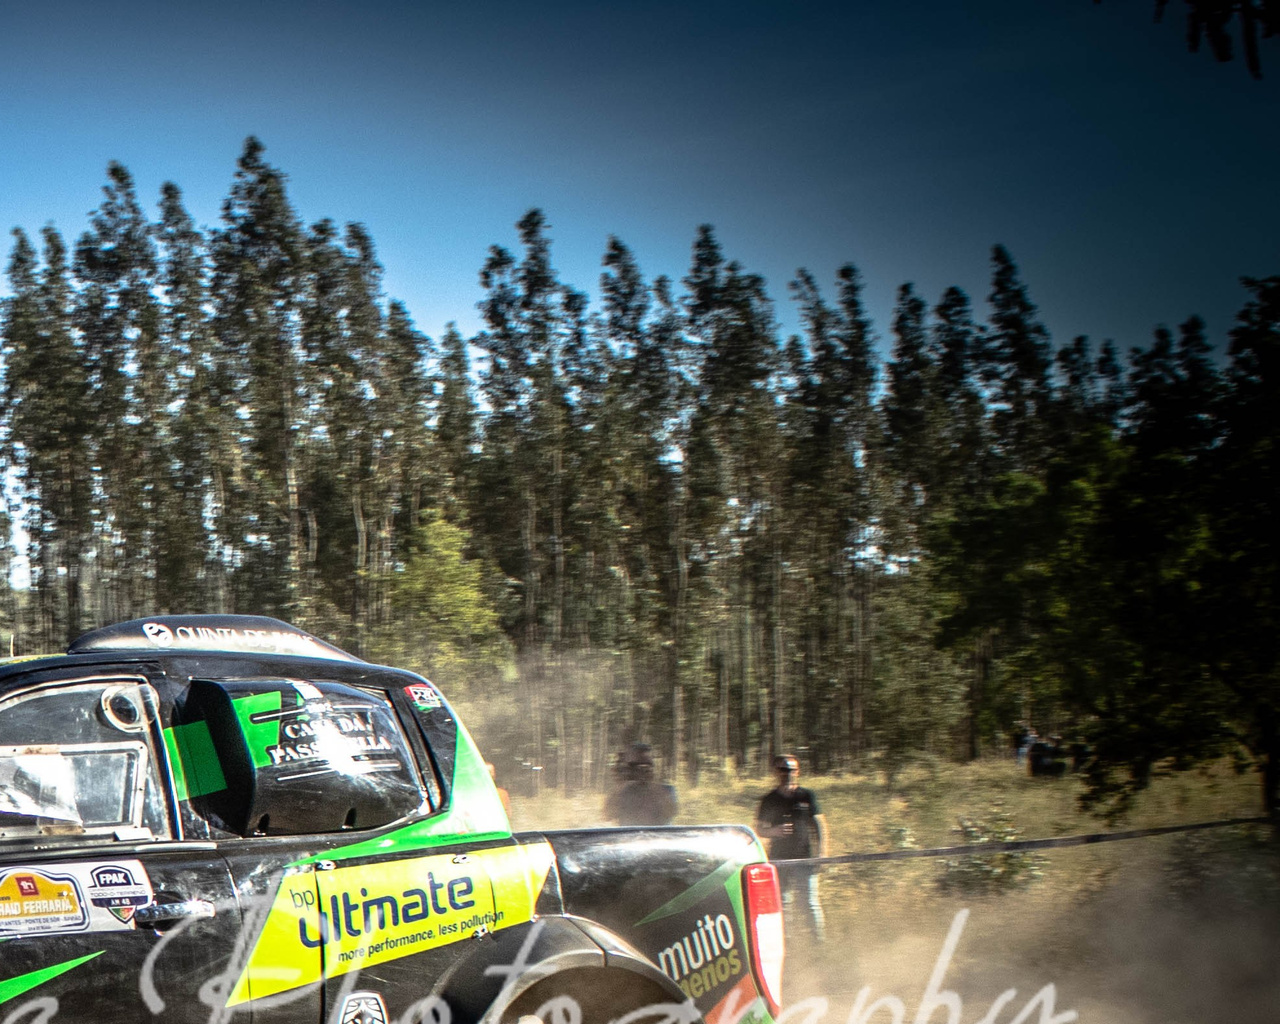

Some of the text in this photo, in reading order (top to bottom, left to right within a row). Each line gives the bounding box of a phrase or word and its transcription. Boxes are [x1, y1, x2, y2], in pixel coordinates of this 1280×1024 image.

[99, 873, 127, 884] FPAK
[289, 888, 315, 912] bp
[299, 871, 475, 948] ultimate
[338, 910, 504, 962] more performance, less pollution
[658, 913, 734, 981] muito
